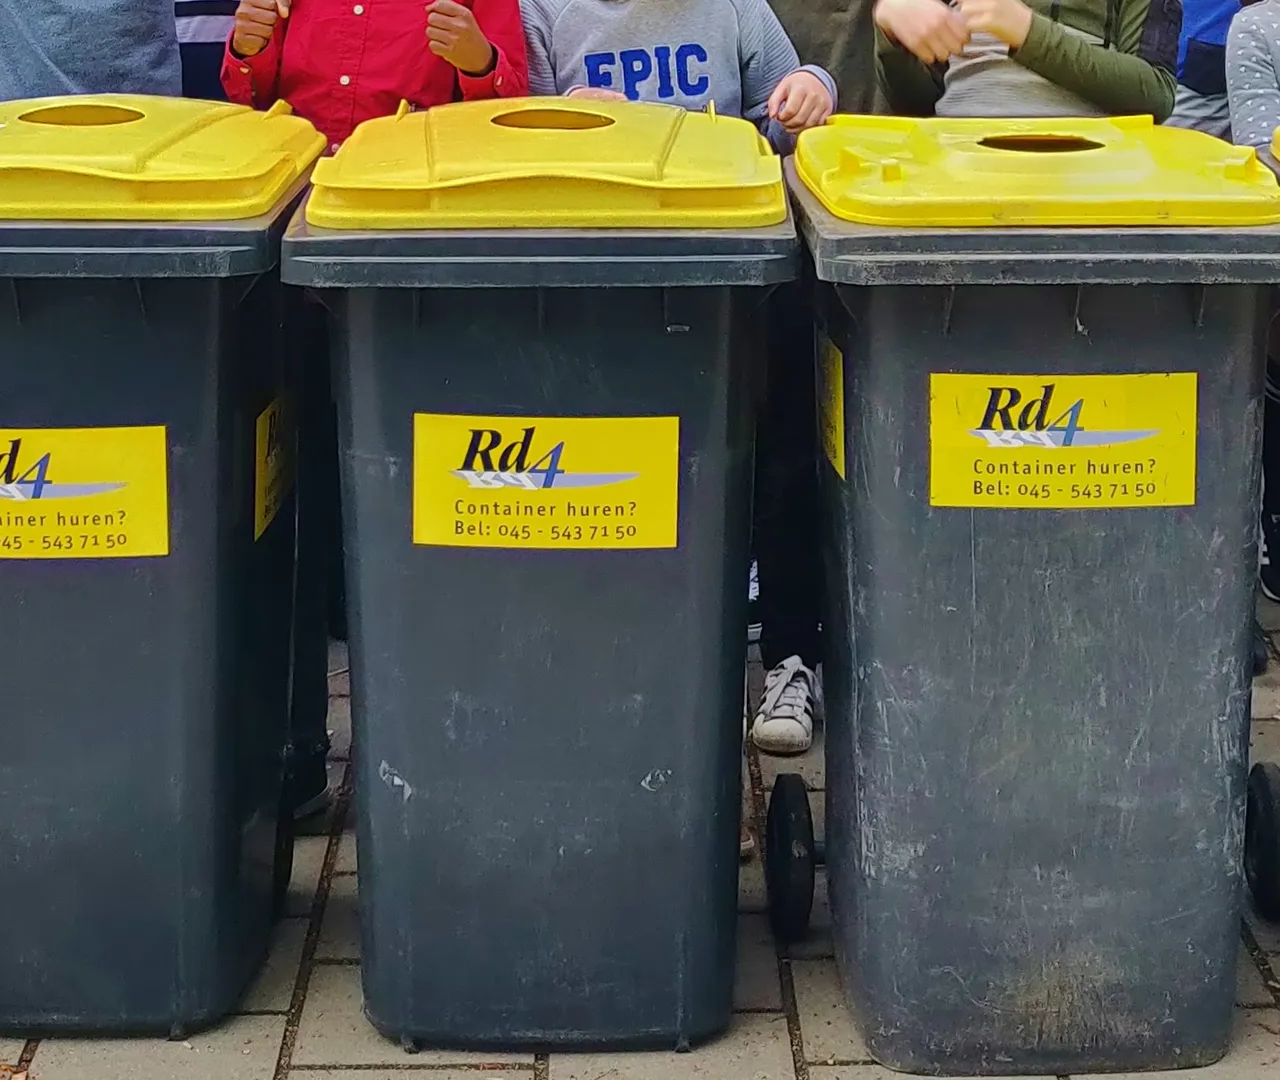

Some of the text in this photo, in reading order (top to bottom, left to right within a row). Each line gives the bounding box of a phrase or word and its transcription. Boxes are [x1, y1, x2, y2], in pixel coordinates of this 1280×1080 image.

[584, 43, 709, 101] EPIC
[976, 383, 1084, 446] Rd4
[457, 426, 564, 488] Rd4
[973, 458, 1156, 475] Container huren?
[973, 479, 1010, 496] Bel:
[454, 499, 637, 517] Container huren?
[56, 509, 127, 527] huren?
[454, 519, 491, 536] Bel:
